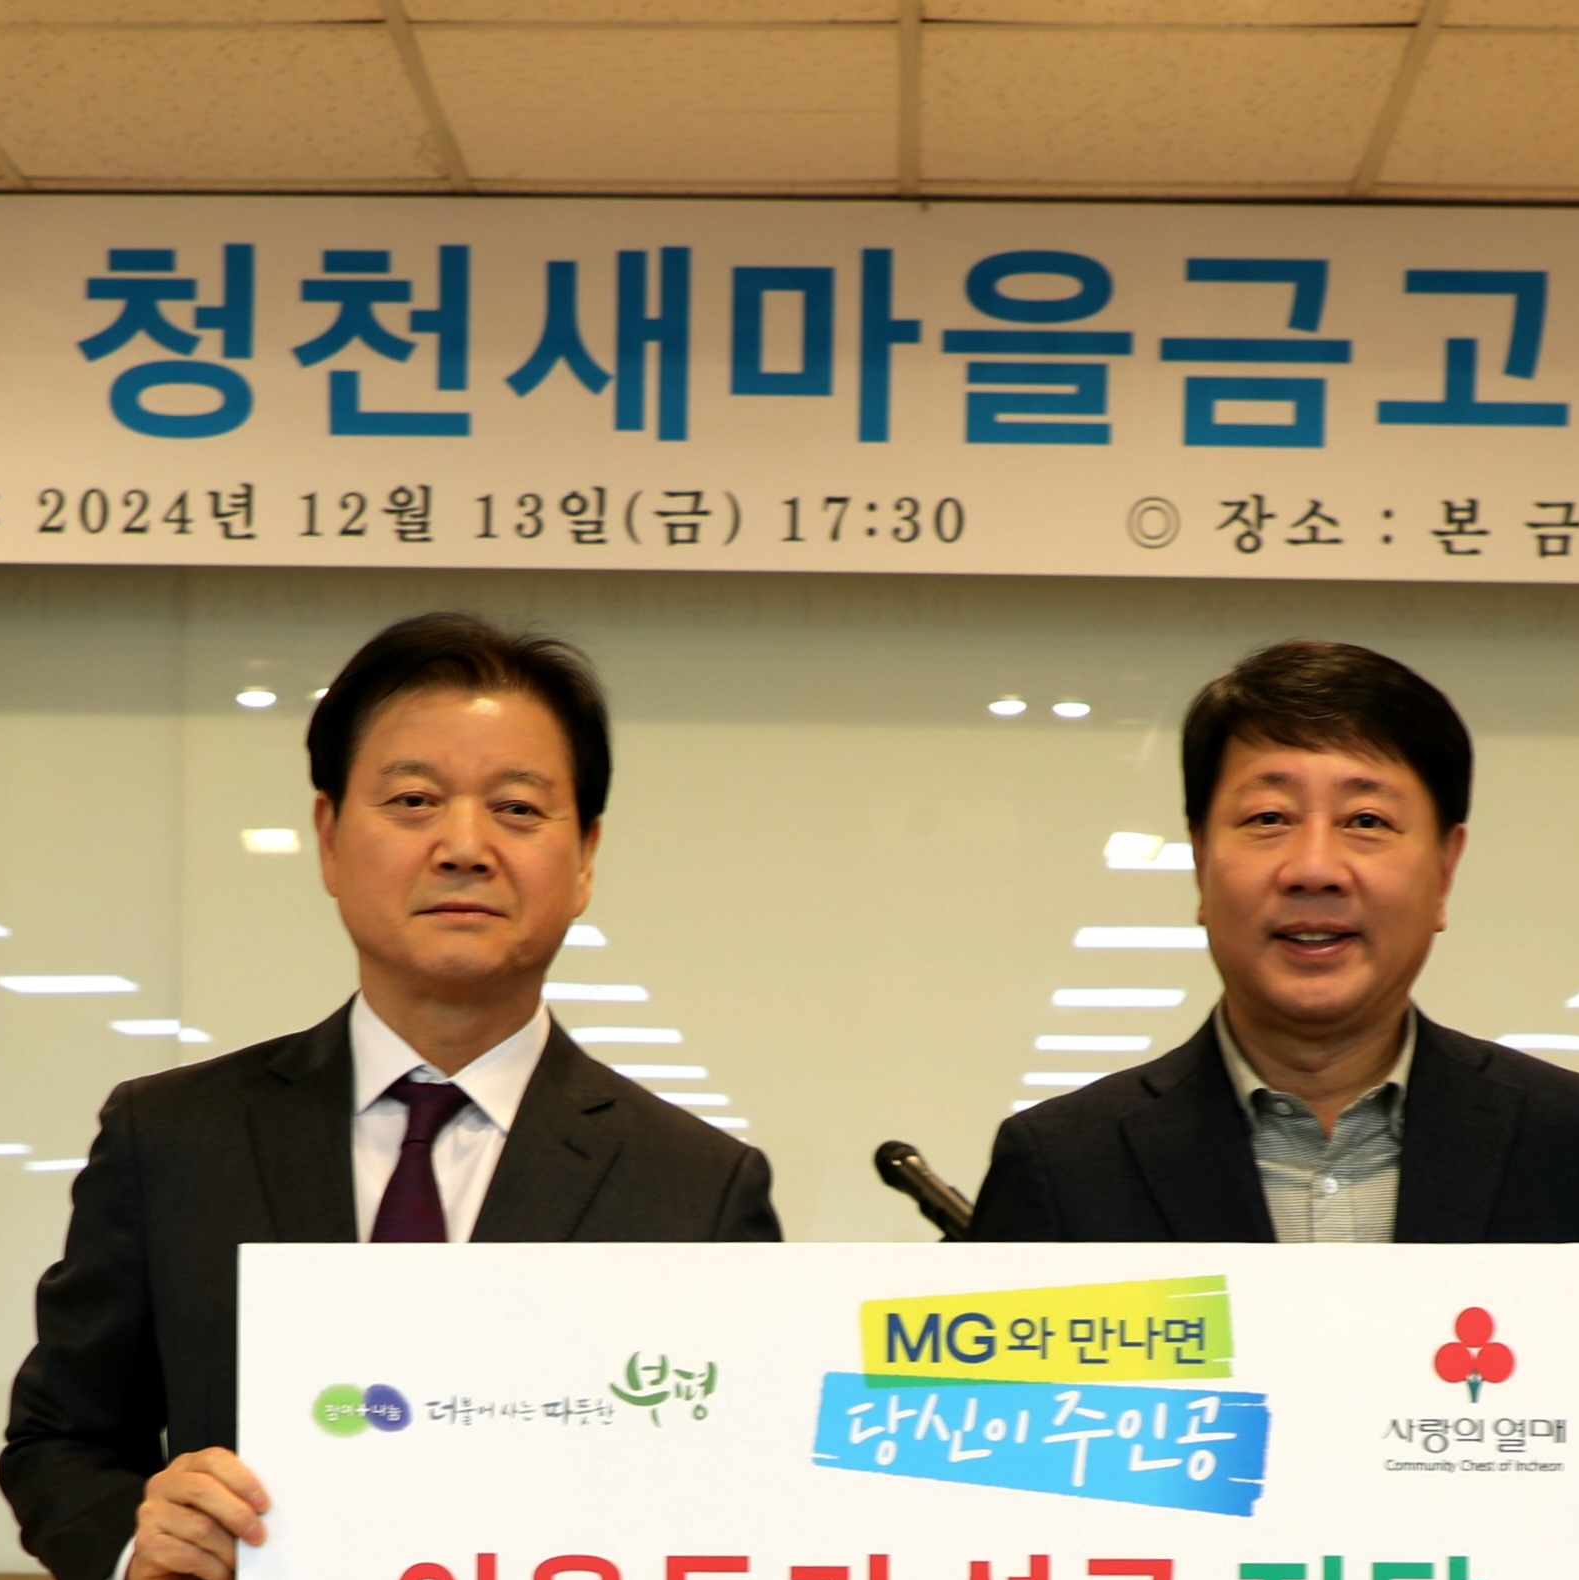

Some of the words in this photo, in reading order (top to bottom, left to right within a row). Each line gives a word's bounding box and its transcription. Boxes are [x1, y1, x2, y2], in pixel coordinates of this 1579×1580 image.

[77, 242, 1570, 448] 청천새마을금고
[37, 482, 257, 541] 2024년
[300, 484, 434, 544] 12월
[475, 485, 742, 550] 13일(금)
[781, 495, 966, 545] 17:30
[1216, 493, 1345, 555] 장소
[1430, 497, 1491, 556] 본
[885, 1311, 1056, 1364] MG와
[1068, 1316, 1207, 1365] 만나면
[424, 1396, 495, 1427] 더불어
[500, 1400, 537, 1422] 사는
[540, 1396, 617, 1426] 따뜻한
[609, 1350, 718, 1428] 부평
[845, 1393, 1030, 1466] 당신이
[1041, 1389, 1238, 1488] 주인공
[1382, 1417, 1485, 1454] 사랑의
[1492, 1417, 1567, 1453] 열매
[1384, 1459, 1457, 1473] Community
[1459, 1459, 1496, 1472] Chest
[1499, 1460, 1513, 1472] of
[1515, 1460, 1564, 1472] Incheon
